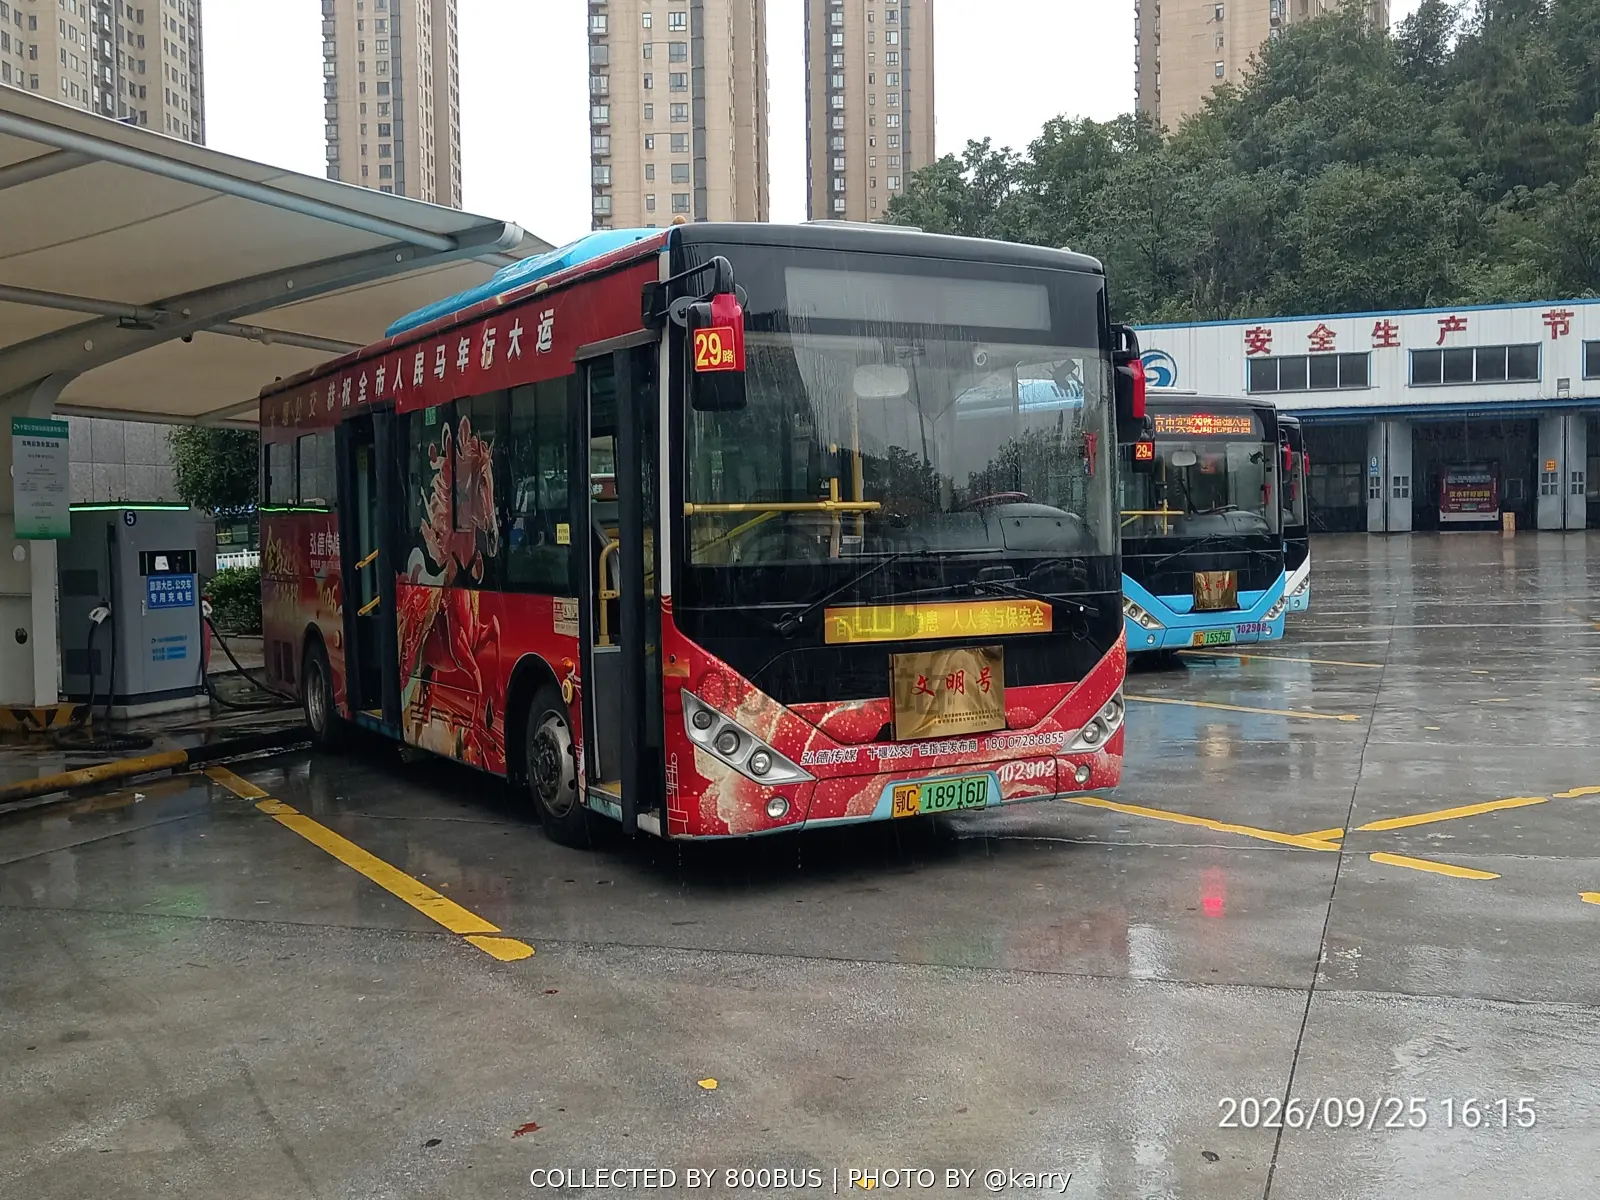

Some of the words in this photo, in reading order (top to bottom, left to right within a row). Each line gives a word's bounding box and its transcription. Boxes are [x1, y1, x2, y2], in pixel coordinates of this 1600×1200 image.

[1244, 314, 1468, 355] 安全生产
[1542, 308, 1575, 340] 节
[696, 332, 734, 367] 29路
[126, 511, 134, 525] 5
[951, 606, 1044, 630] 人人参与保安全
[911, 666, 993, 697] 文明号
[800, 748, 859, 765] 弘德传媒
[867, 738, 978, 760] 十堰公交广告指定发布商
[984, 737, 1005, 751] 180
